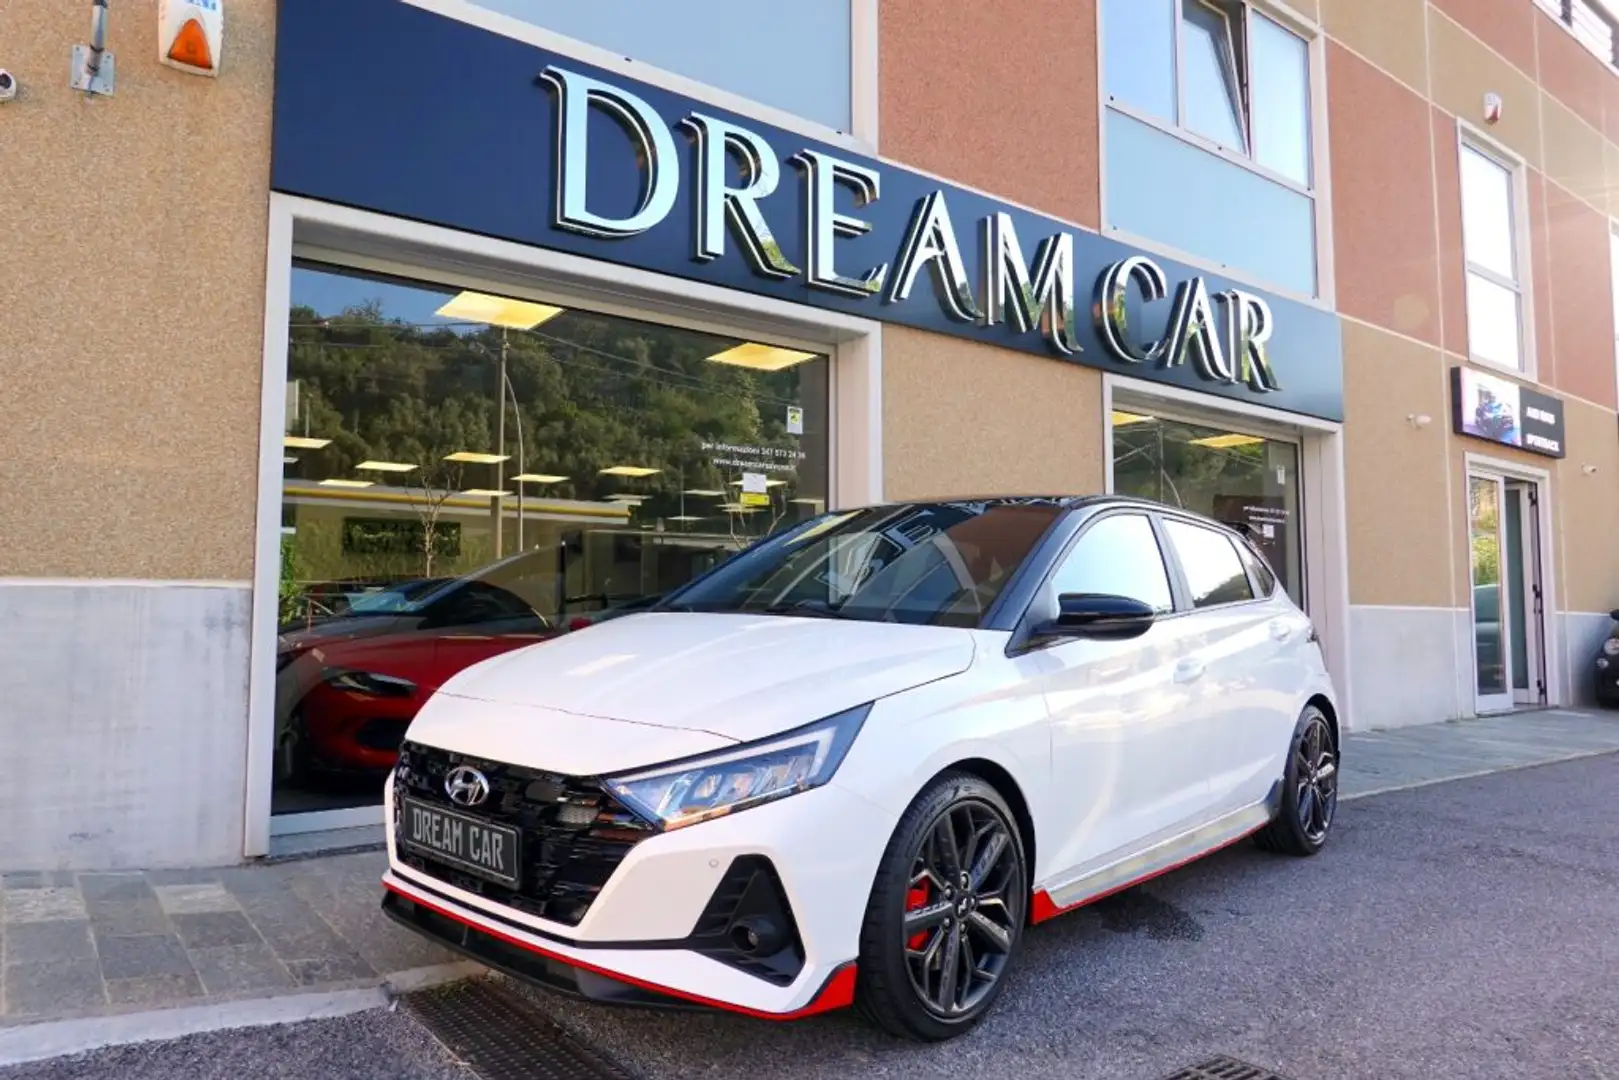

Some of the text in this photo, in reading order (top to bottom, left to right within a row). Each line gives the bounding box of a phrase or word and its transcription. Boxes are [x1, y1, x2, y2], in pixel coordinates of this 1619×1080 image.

[539, 64, 1282, 392] DREAM CAR
[413, 807, 504, 870] DREAM CAR
